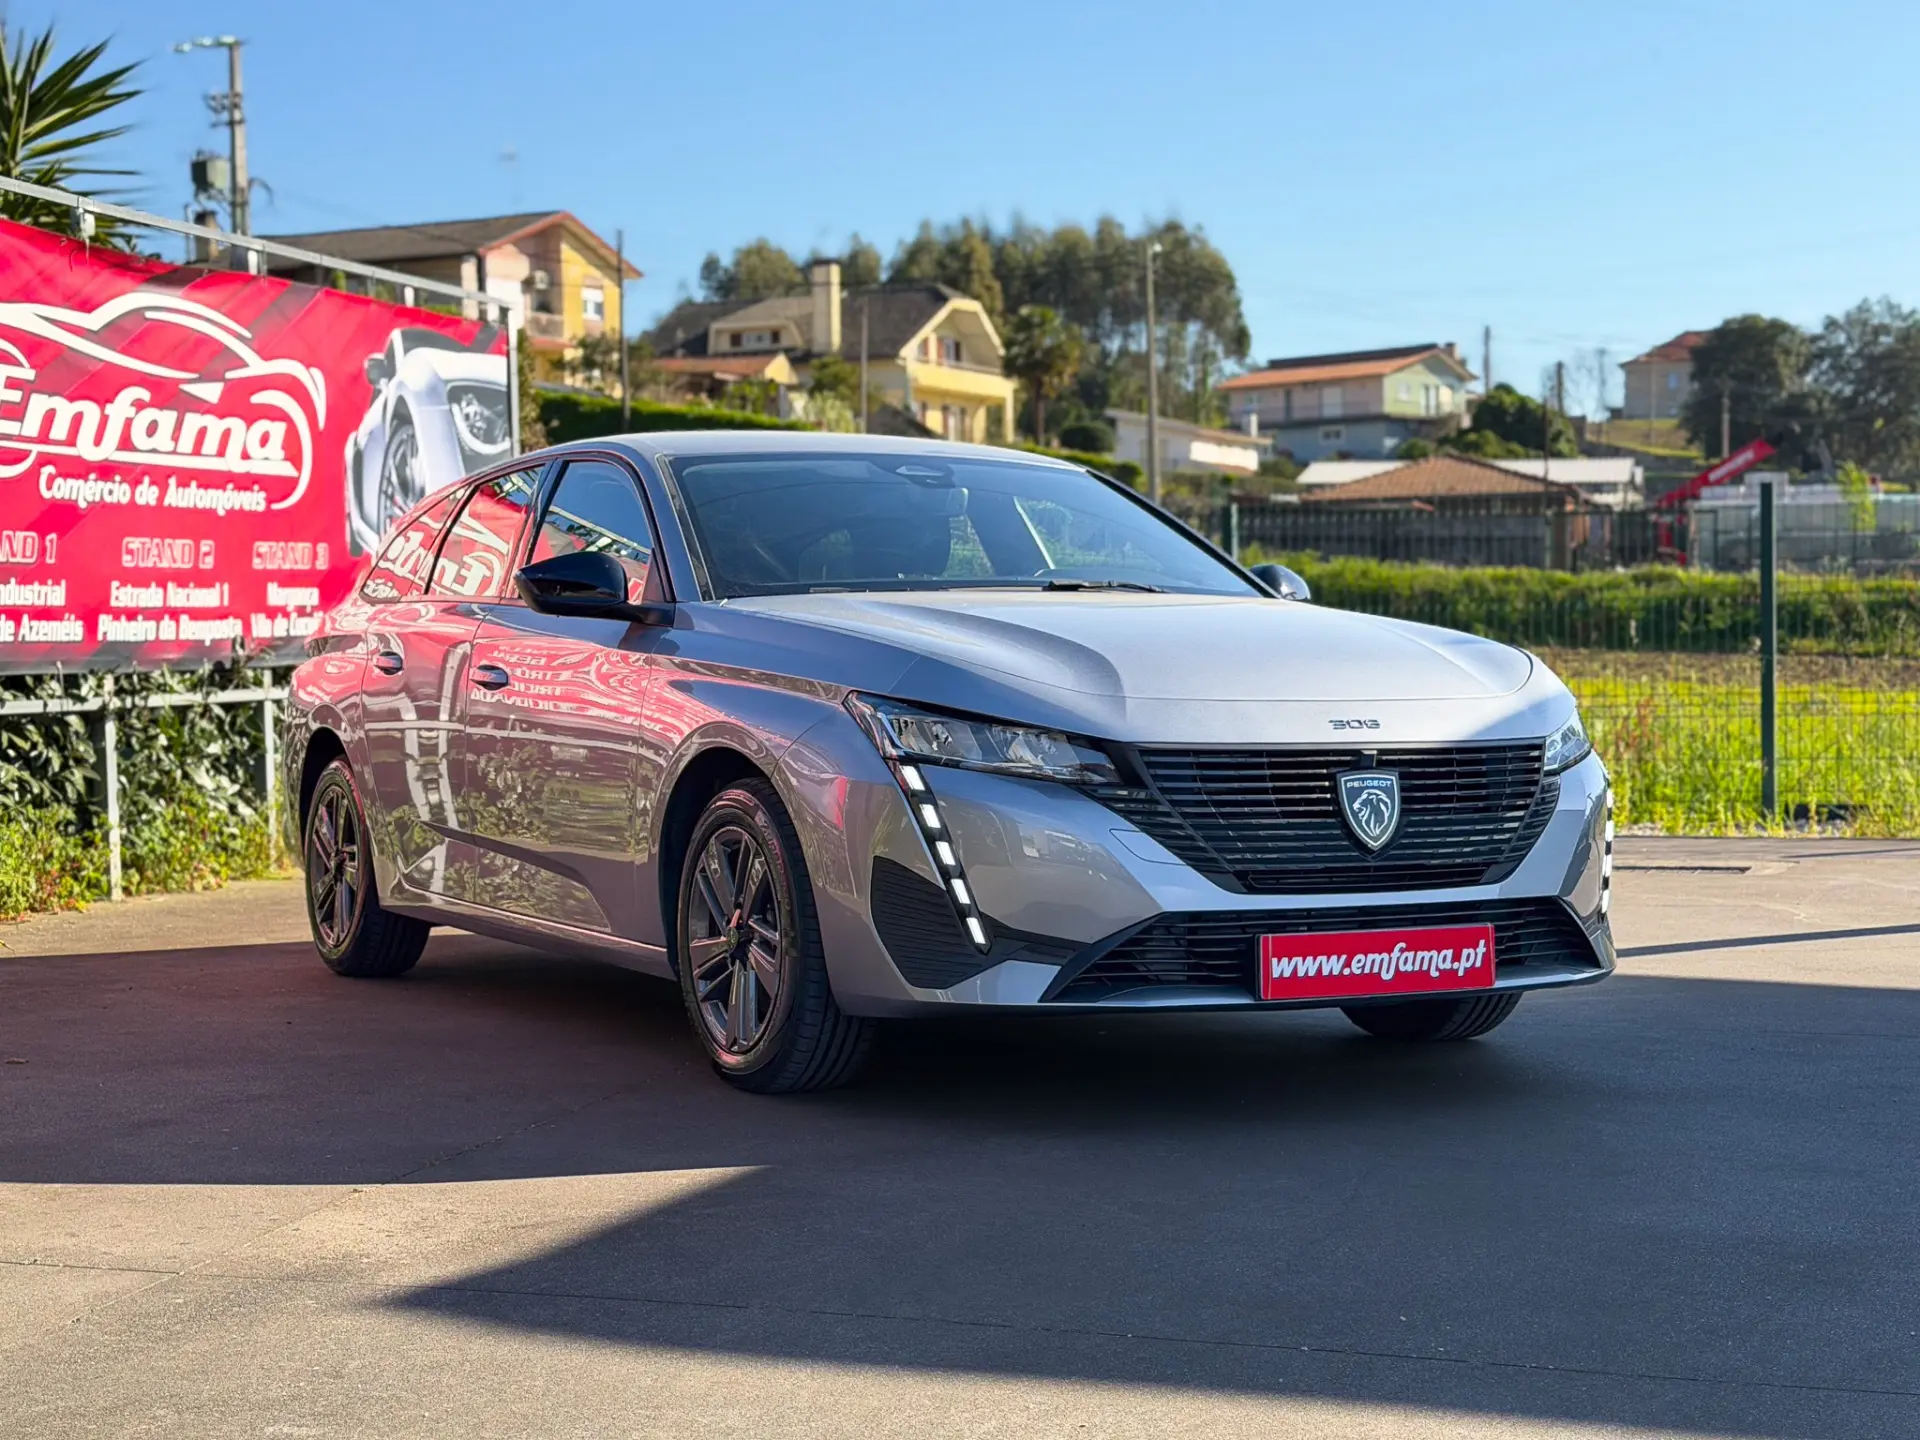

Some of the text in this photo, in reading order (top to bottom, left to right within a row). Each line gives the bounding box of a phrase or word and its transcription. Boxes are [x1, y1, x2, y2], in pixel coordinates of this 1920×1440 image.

[0, 365, 287, 472] Emfama
[39, 465, 266, 516] Comércio de Automóveis
[45, 533, 57, 564] 1
[122, 537, 215, 569] STAND 2
[252, 541, 313, 570] STAND
[0, 577, 66, 606] ndustrial
[110, 580, 164, 607] Estrada
[166, 581, 220, 607] Nacional
[18, 613, 84, 642] Azeméis
[98, 614, 156, 642] Pinheiro
[158, 613, 176, 641] da
[1346, 779, 1392, 789] PEUGEOT
[1271, 939, 1487, 981] www.emfama.pt
